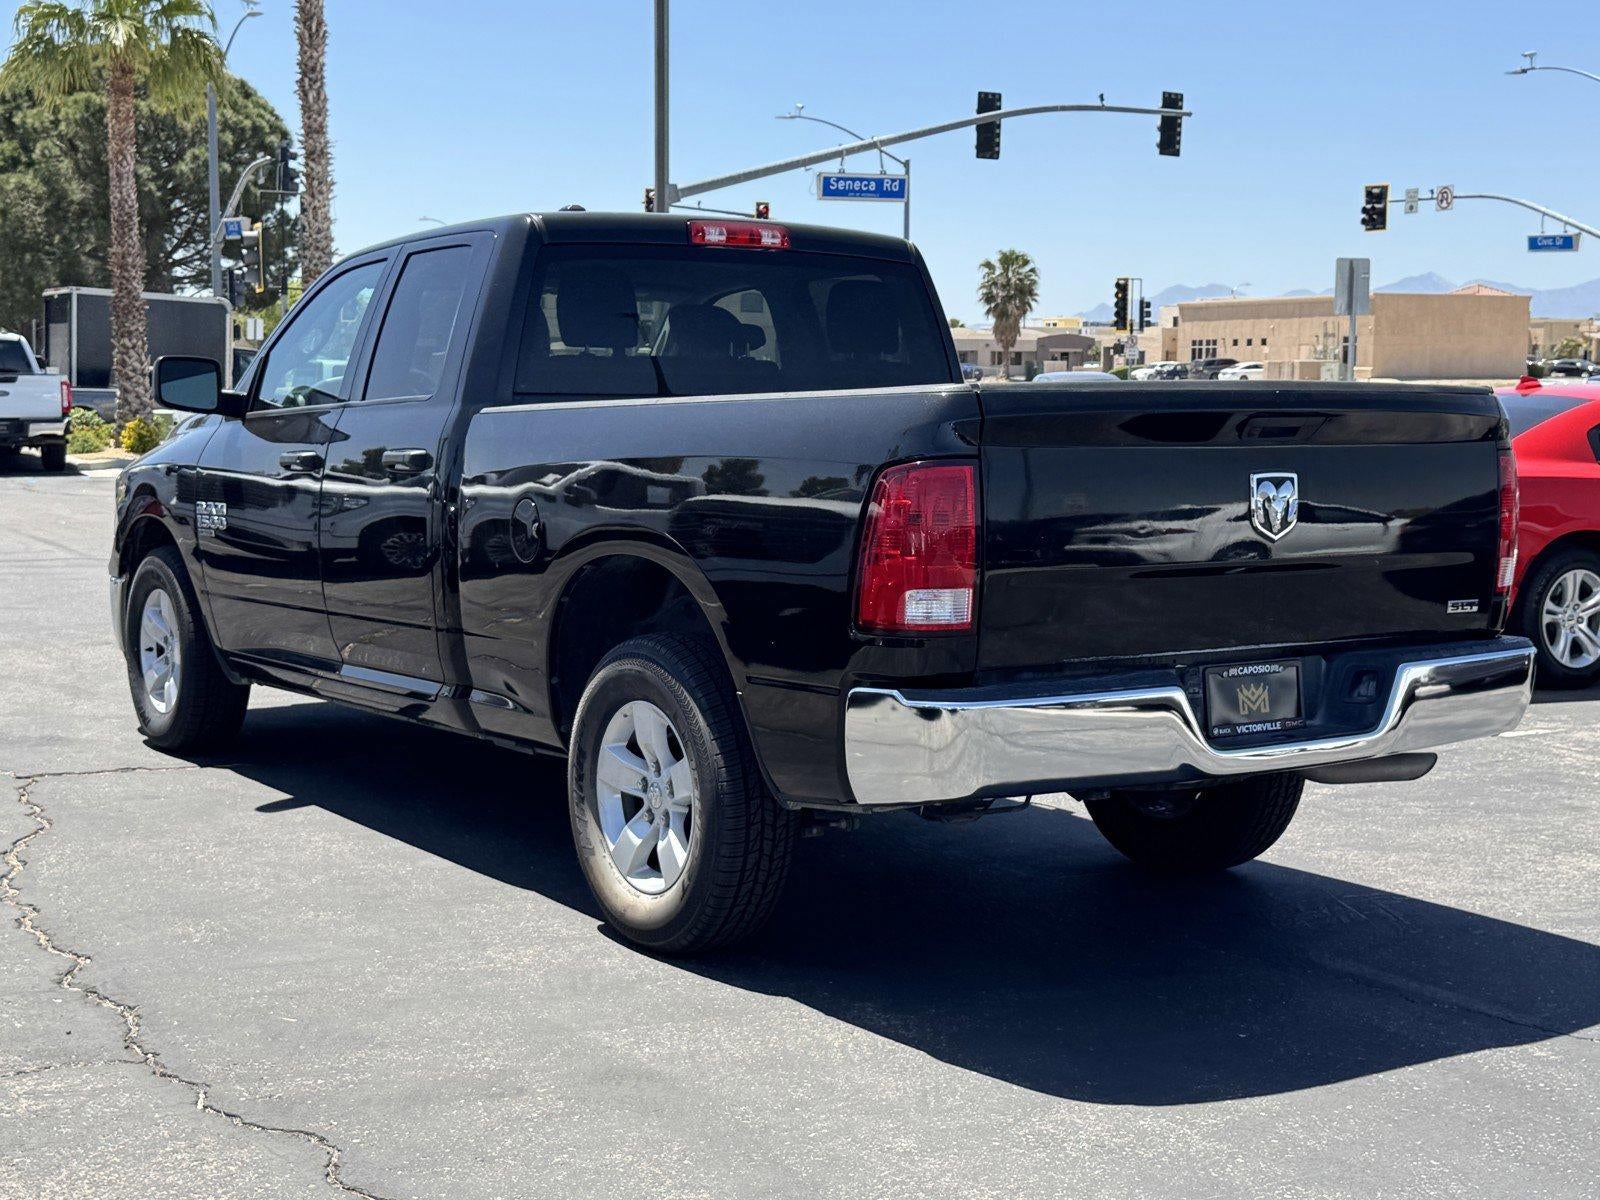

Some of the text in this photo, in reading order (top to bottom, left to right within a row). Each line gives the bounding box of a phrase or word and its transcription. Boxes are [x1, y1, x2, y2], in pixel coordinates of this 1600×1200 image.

[829, 177, 899, 191] Seneca Rd
[1537, 236, 1564, 246] Civic Dr
[1447, 599, 1479, 613] SLT
[1236, 721, 1282, 733] VICTORVILLE
[1285, 720, 1304, 728] GMC
